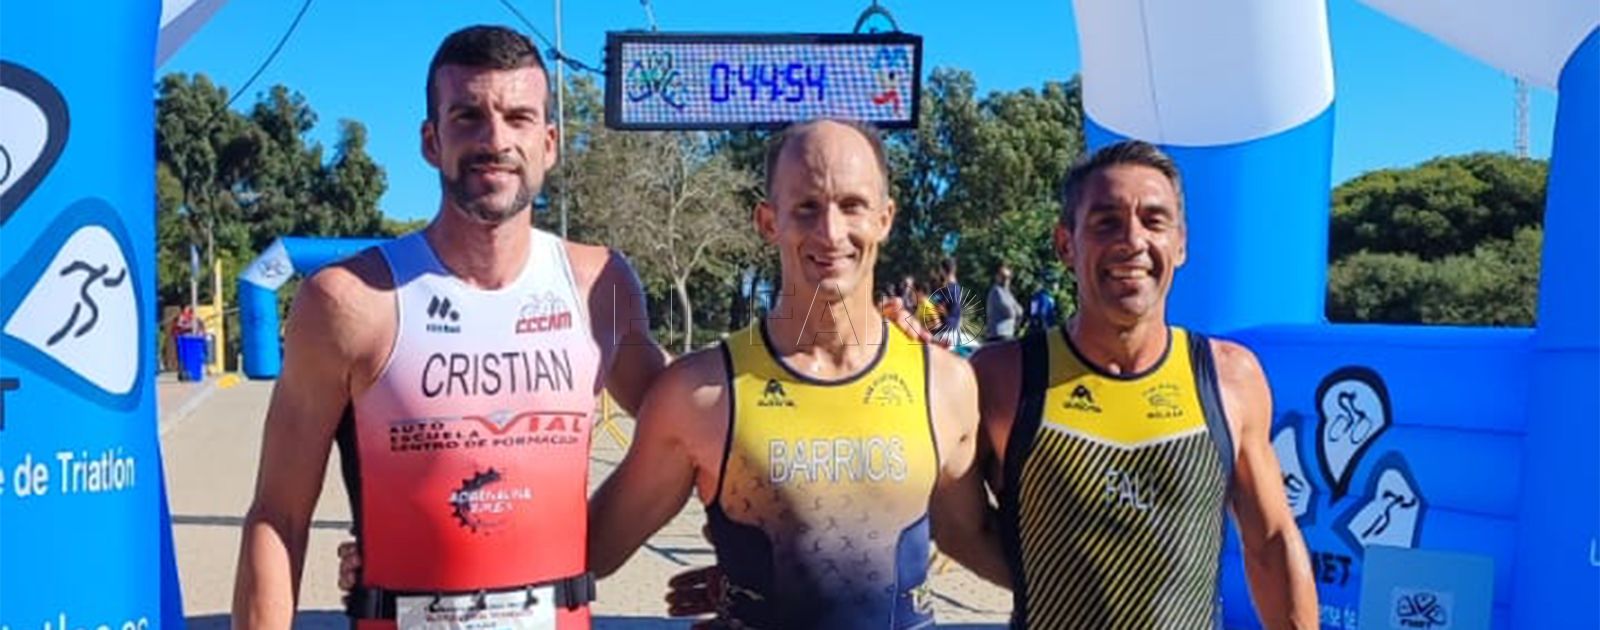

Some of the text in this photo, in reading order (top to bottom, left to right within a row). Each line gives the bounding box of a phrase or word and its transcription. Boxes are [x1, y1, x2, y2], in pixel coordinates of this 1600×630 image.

[709, 61, 828, 103] 0:44:54
[421, 350, 575, 399] CRISTIAN
[390, 421, 445, 435] AUTO
[390, 429, 480, 445] ESCUELA
[13, 453, 49, 498] de
[56, 447, 136, 495] Triatlón
[768, 434, 910, 486] BARRIOS
